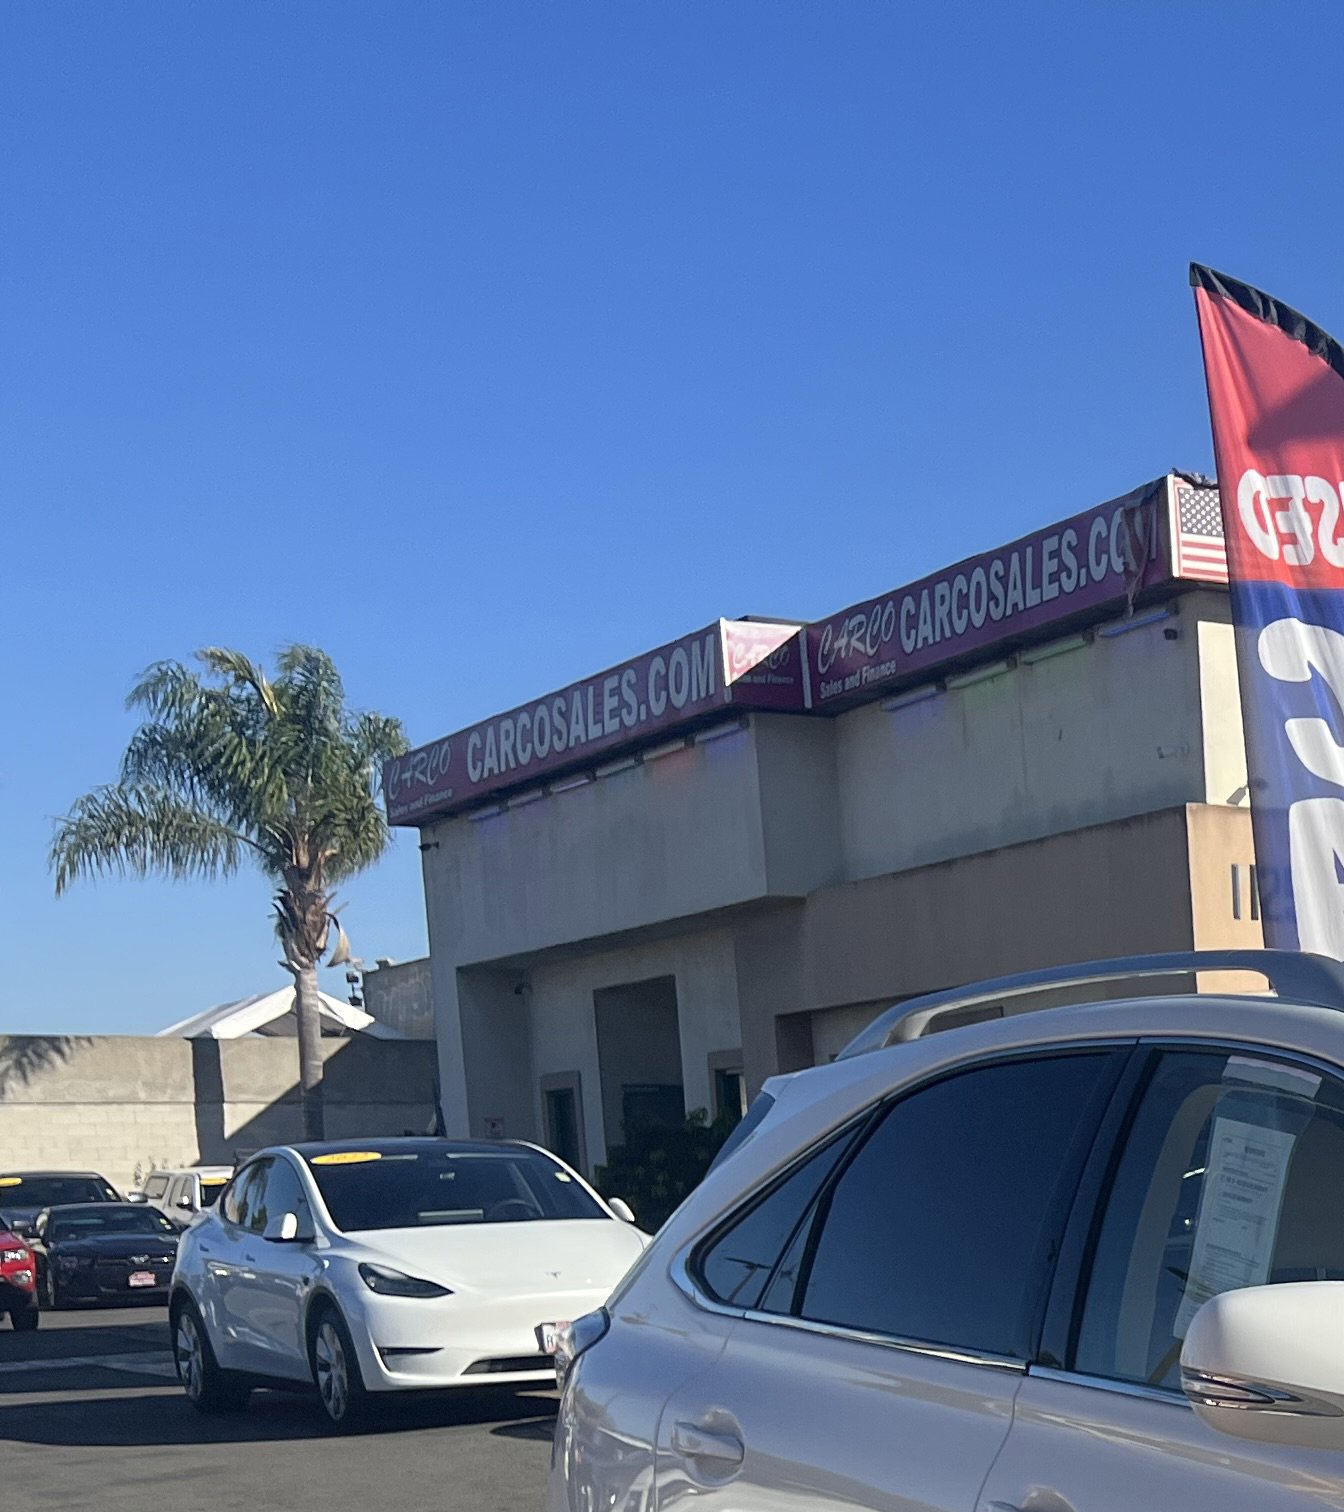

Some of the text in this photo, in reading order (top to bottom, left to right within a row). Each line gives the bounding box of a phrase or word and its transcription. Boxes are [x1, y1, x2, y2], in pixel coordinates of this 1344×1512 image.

[817, 600, 896, 675] CARCO
[466, 633, 716, 784] CARCOSALES.COM
[819, 659, 897, 700] Sales and Finance
[389, 743, 451, 801] CARCO
